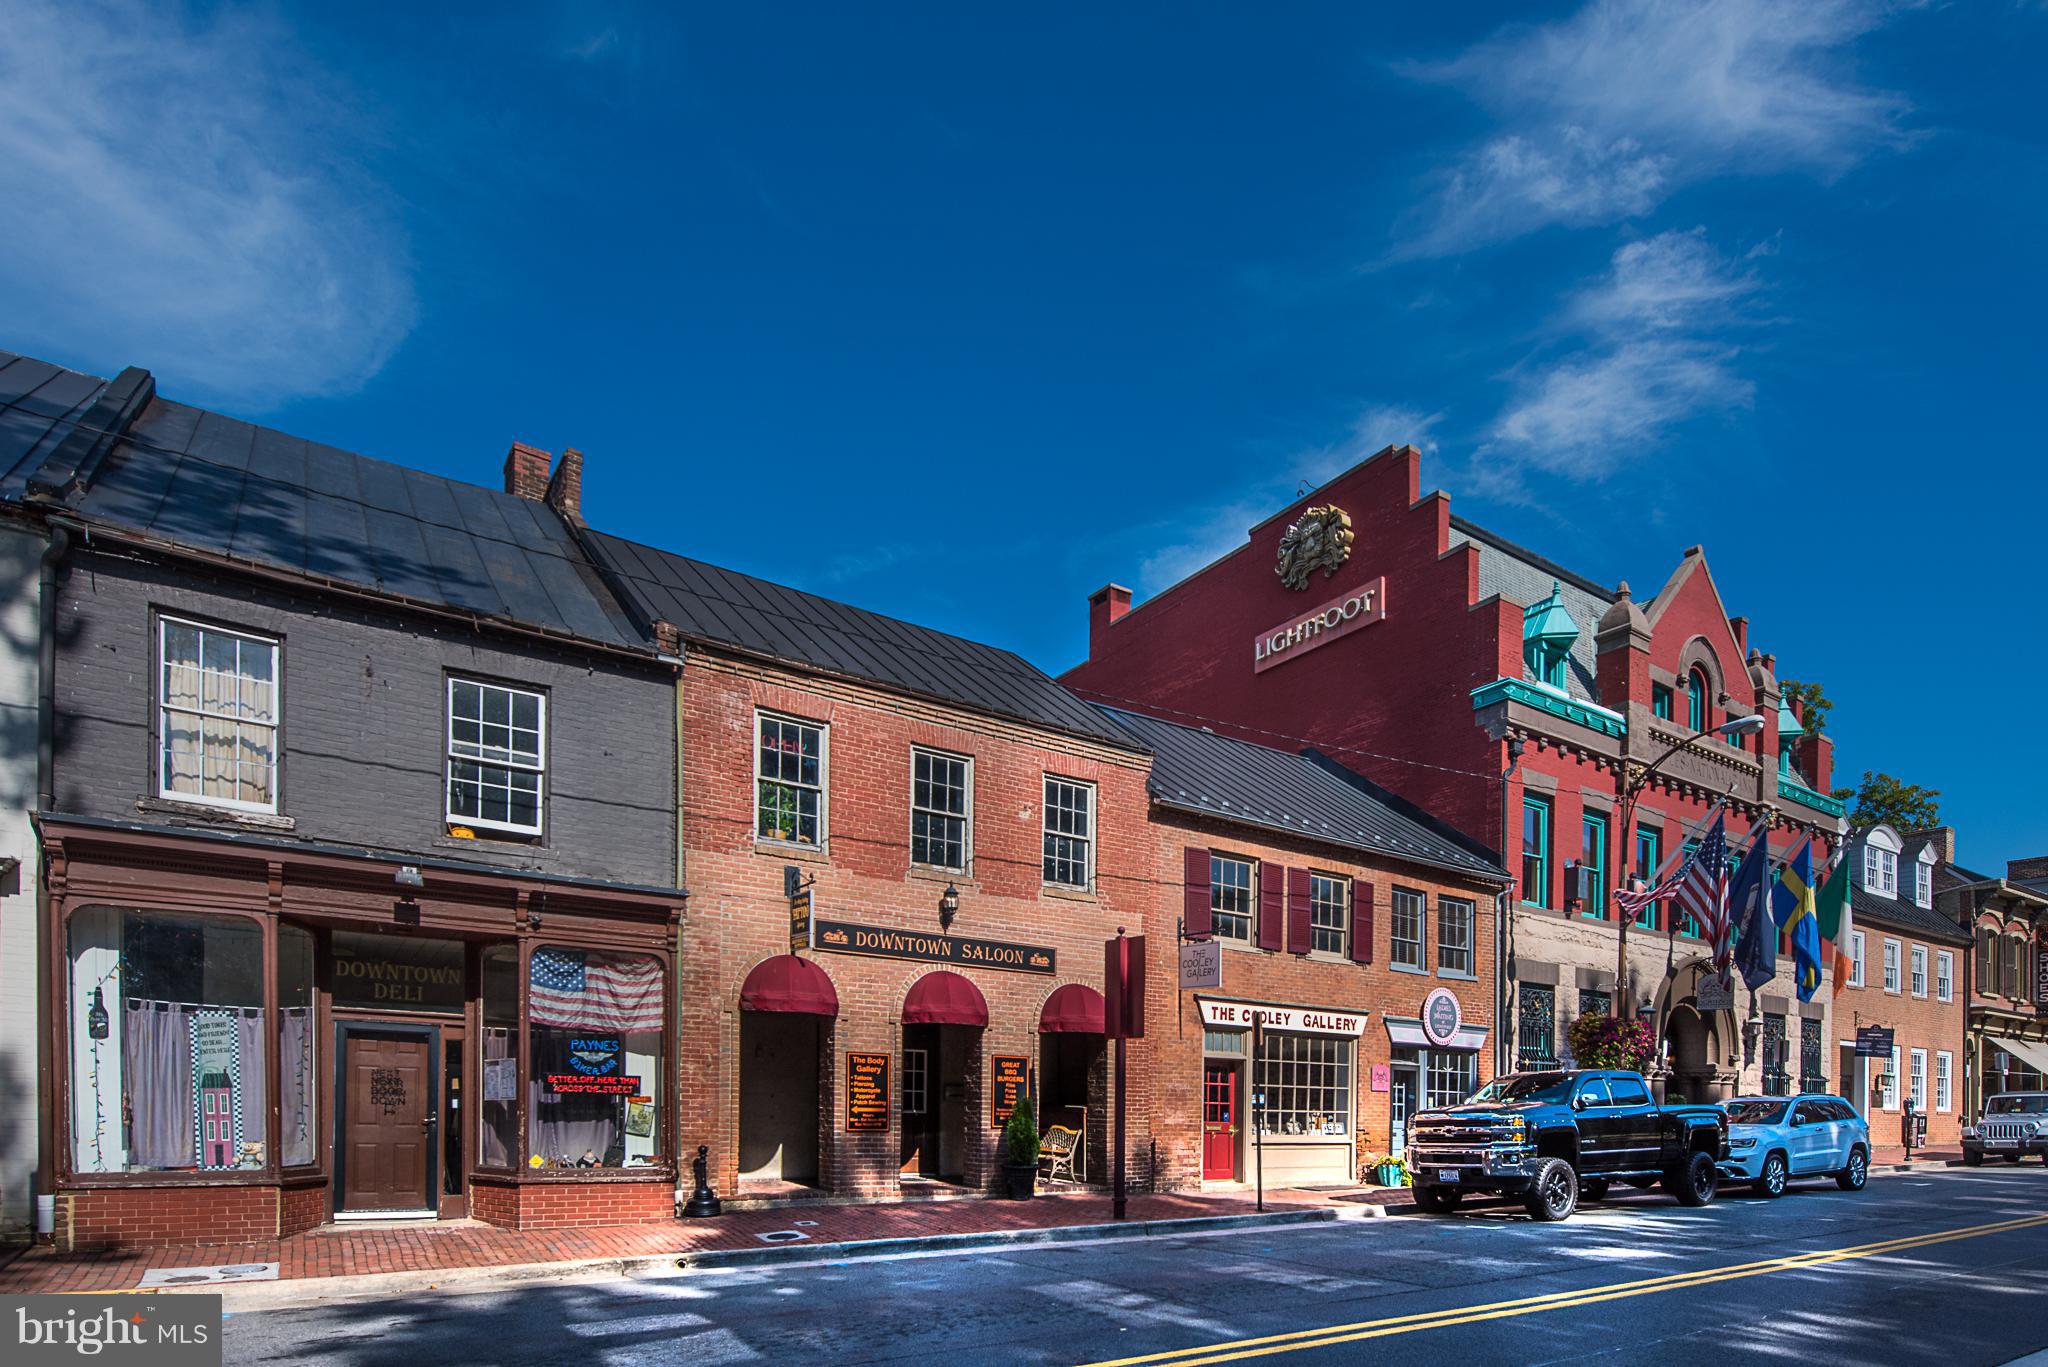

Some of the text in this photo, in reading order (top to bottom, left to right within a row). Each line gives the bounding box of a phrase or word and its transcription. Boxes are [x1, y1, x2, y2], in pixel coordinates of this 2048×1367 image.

[1255, 589, 1375, 661] LIGHTFOOT
[855, 931, 1025, 964] DOWNTOWN SALOON
[1192, 949, 1206, 958] THE
[1182, 957, 1214, 968] COOLEY
[336, 960, 461, 984] DOWNTOWN
[1186, 967, 1216, 978] GALLERY
[374, 983, 423, 1001] DELI
[1211, 1006, 1235, 1021] THE
[1303, 1014, 1358, 1031] GALLERY
[570, 1039, 620, 1052] PAYNES
[569, 1057, 617, 1075] BIKER BAR
[867, 1057, 885, 1066] Body
[856, 1065, 881, 1074] Gallery
[547, 1075, 639, 1085] BETTER OFF HERE THAN
[997, 1075, 1024, 1083] BURGERS
[553, 1084, 634, 1094] ACROSS THE STREET
